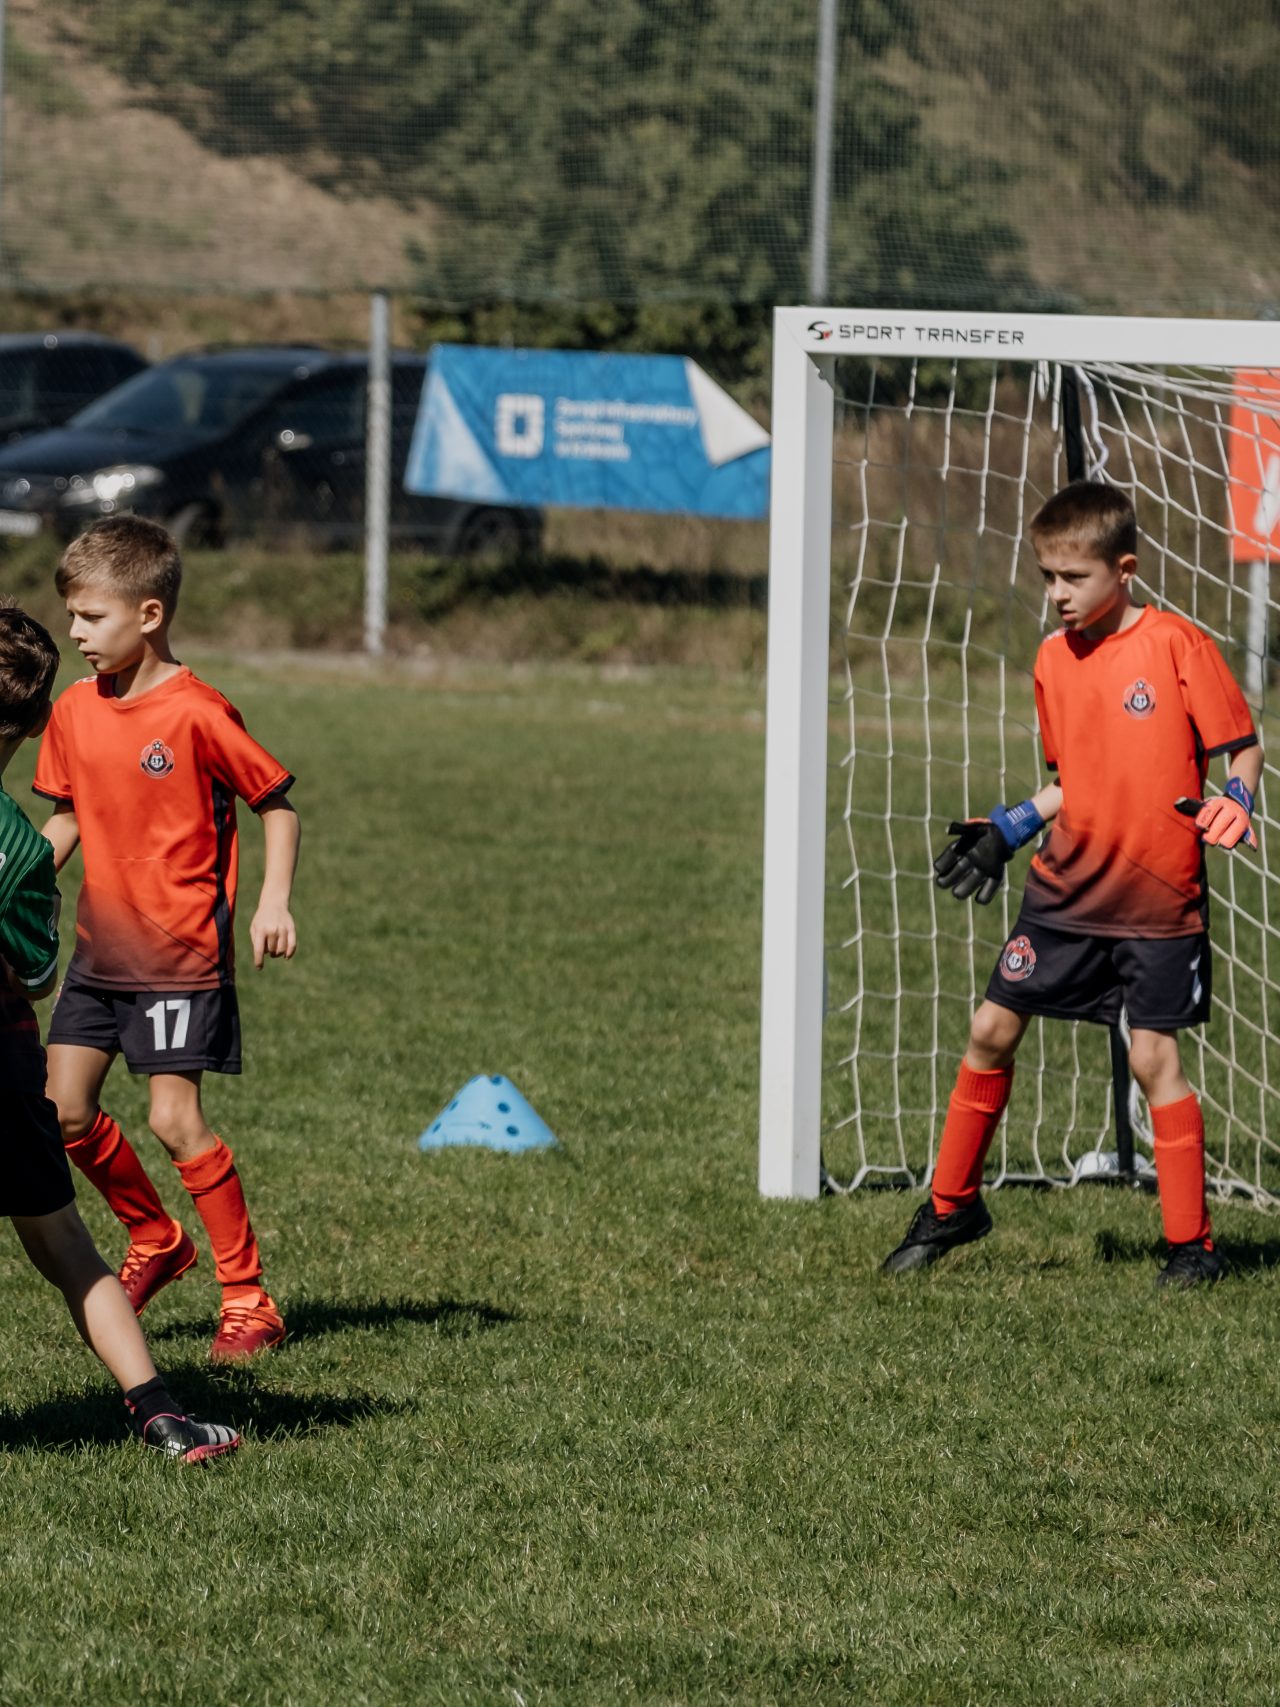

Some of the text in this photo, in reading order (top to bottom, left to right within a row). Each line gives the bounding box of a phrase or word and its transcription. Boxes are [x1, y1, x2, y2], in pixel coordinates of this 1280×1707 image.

[839, 324, 1025, 345] SPORT TRANSFER
[145, 999, 191, 1052] 17
